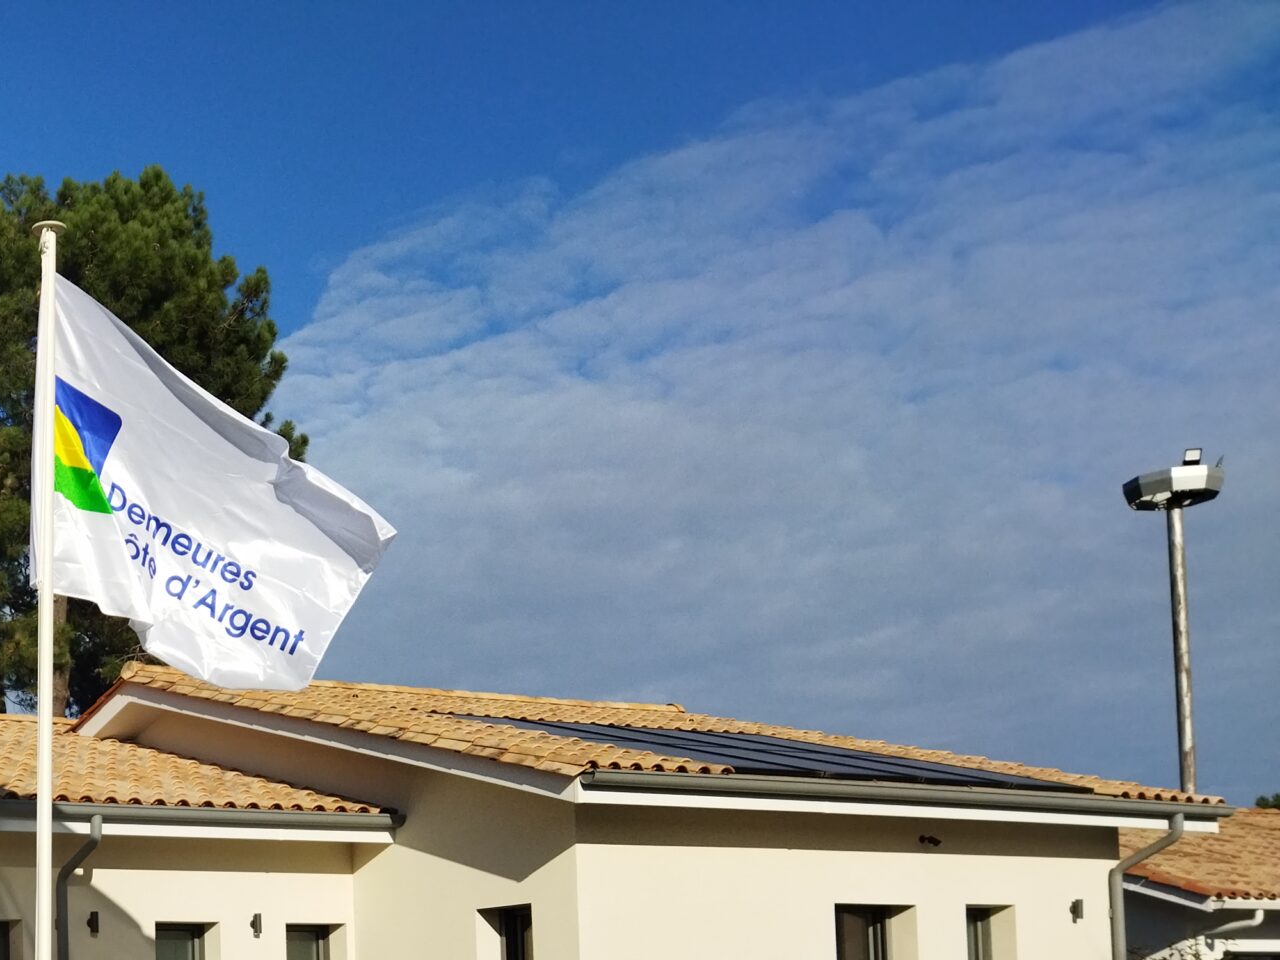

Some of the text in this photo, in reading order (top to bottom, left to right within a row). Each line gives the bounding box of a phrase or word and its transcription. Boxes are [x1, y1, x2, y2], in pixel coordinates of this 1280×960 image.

[107, 482, 257, 591] Demeures
[124, 533, 305, 656] ôte d'Argent
